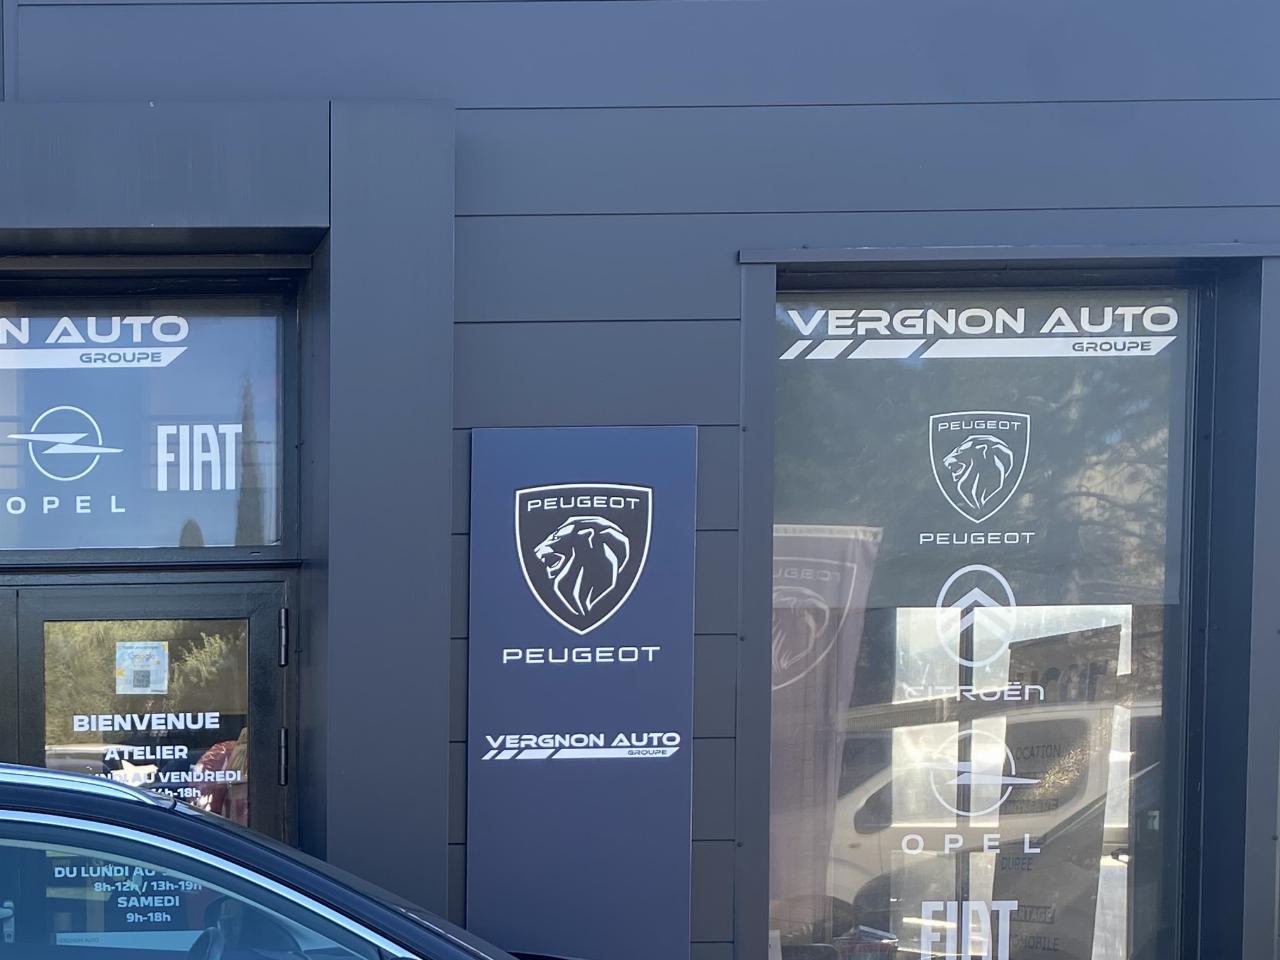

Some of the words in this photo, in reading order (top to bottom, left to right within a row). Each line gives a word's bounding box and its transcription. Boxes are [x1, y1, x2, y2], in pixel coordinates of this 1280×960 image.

[786, 306, 1026, 336] VERGNON
[1039, 305, 1178, 334] AUTO
[45, 315, 190, 345] AUTO
[1072, 340, 1153, 353] GROUPE
[79, 351, 163, 364] GROUPE
[937, 420, 1022, 432] PEUGEOT
[156, 423, 243, 492] FIAT
[6, 495, 126, 515] OPEL
[526, 495, 641, 512] PEUGEOT
[919, 531, 1036, 545] PEUGEOT
[502, 646, 661, 664] PEUGEOT
[72, 711, 221, 732] BIENVENUE
[485, 733, 609, 749] VERGNON
[610, 732, 681, 747] AUTO
[105, 745, 188, 761] ATELIER
[159, 770, 242, 783] VENDREDI
[901, 833, 1041, 854] OPEL
[54, 867, 77, 878] DU
[80, 866, 129, 878] LUNDI
[117, 896, 180, 908] SAMEDI
[126, 912, 171, 922] 9h-18h
